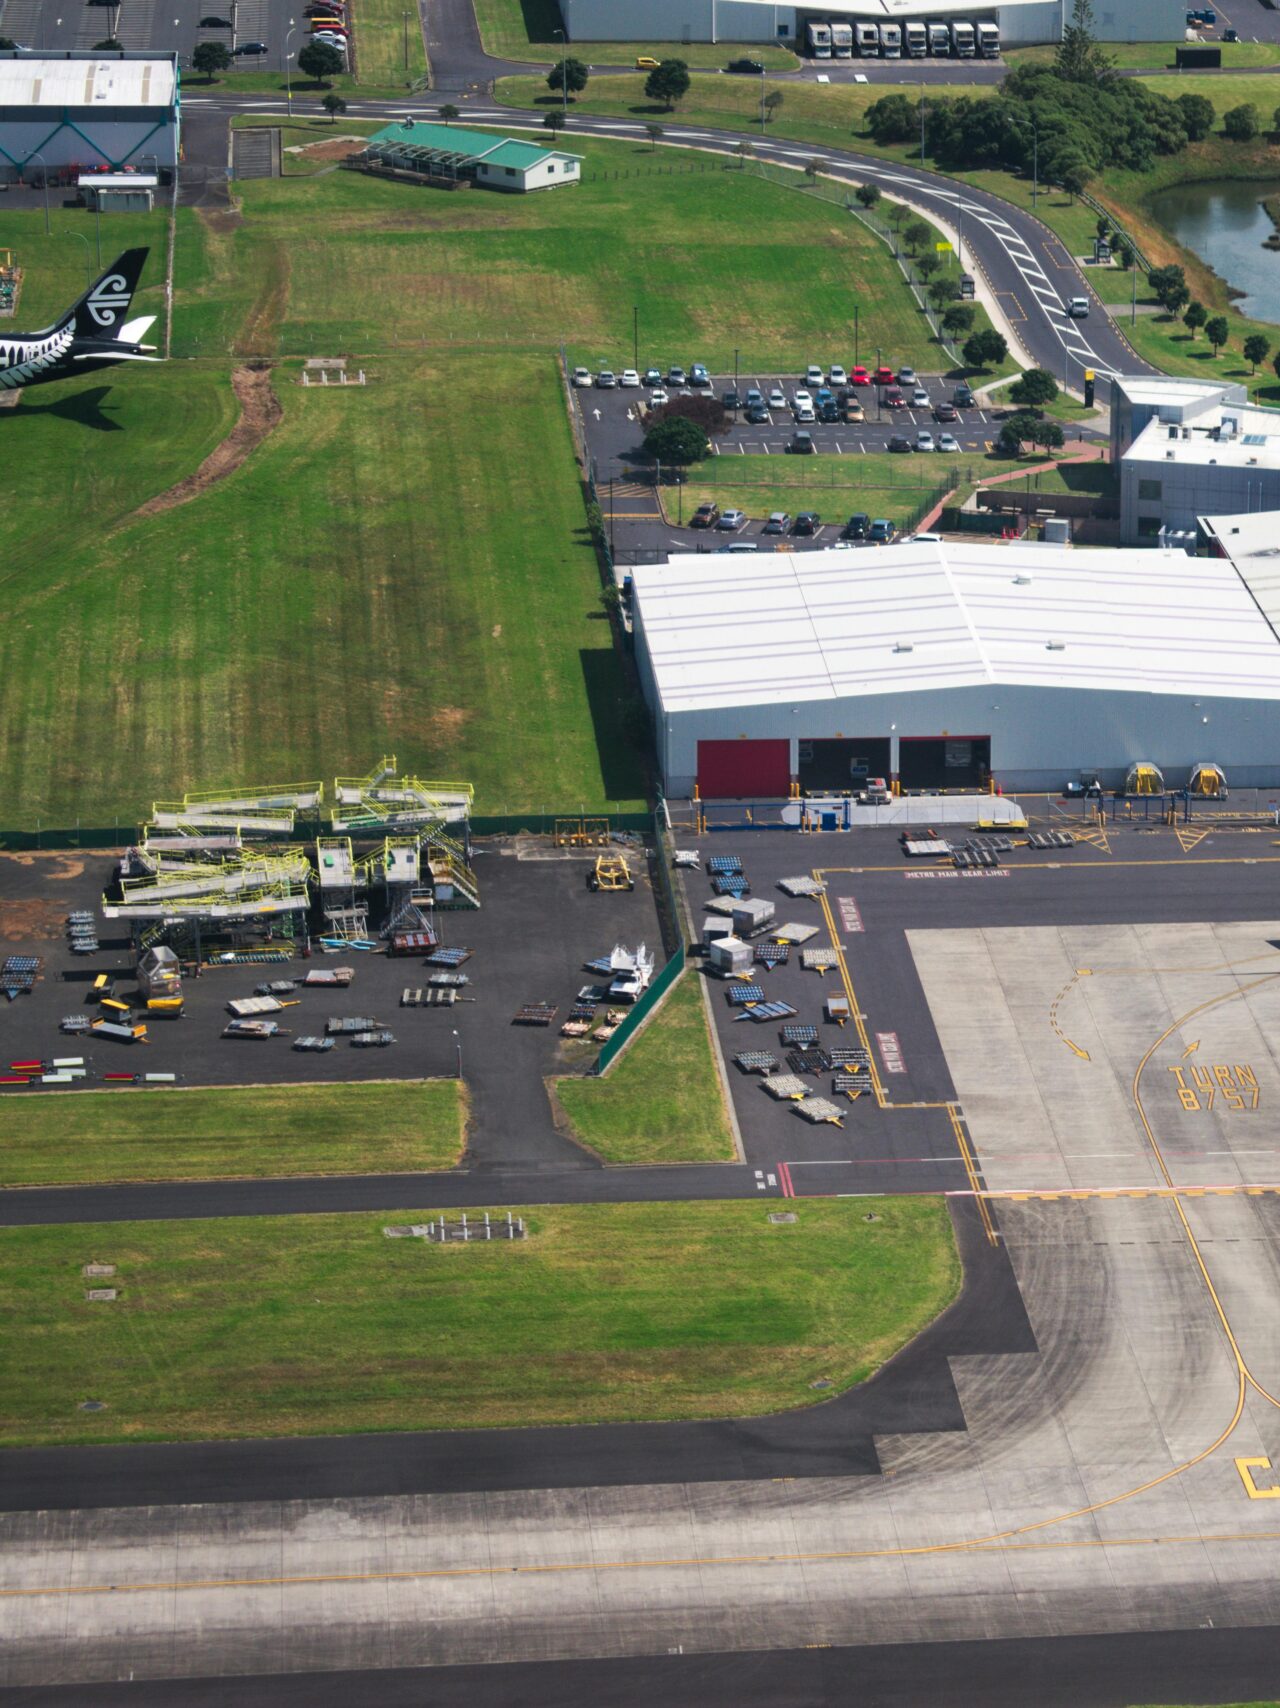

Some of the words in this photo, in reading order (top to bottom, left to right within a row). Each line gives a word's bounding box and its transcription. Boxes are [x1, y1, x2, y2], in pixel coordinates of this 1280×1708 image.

[985, 869, 1009, 877] LIMIT
[1167, 1064, 1258, 1088] TURN
[1177, 1087, 1260, 1111] B757
